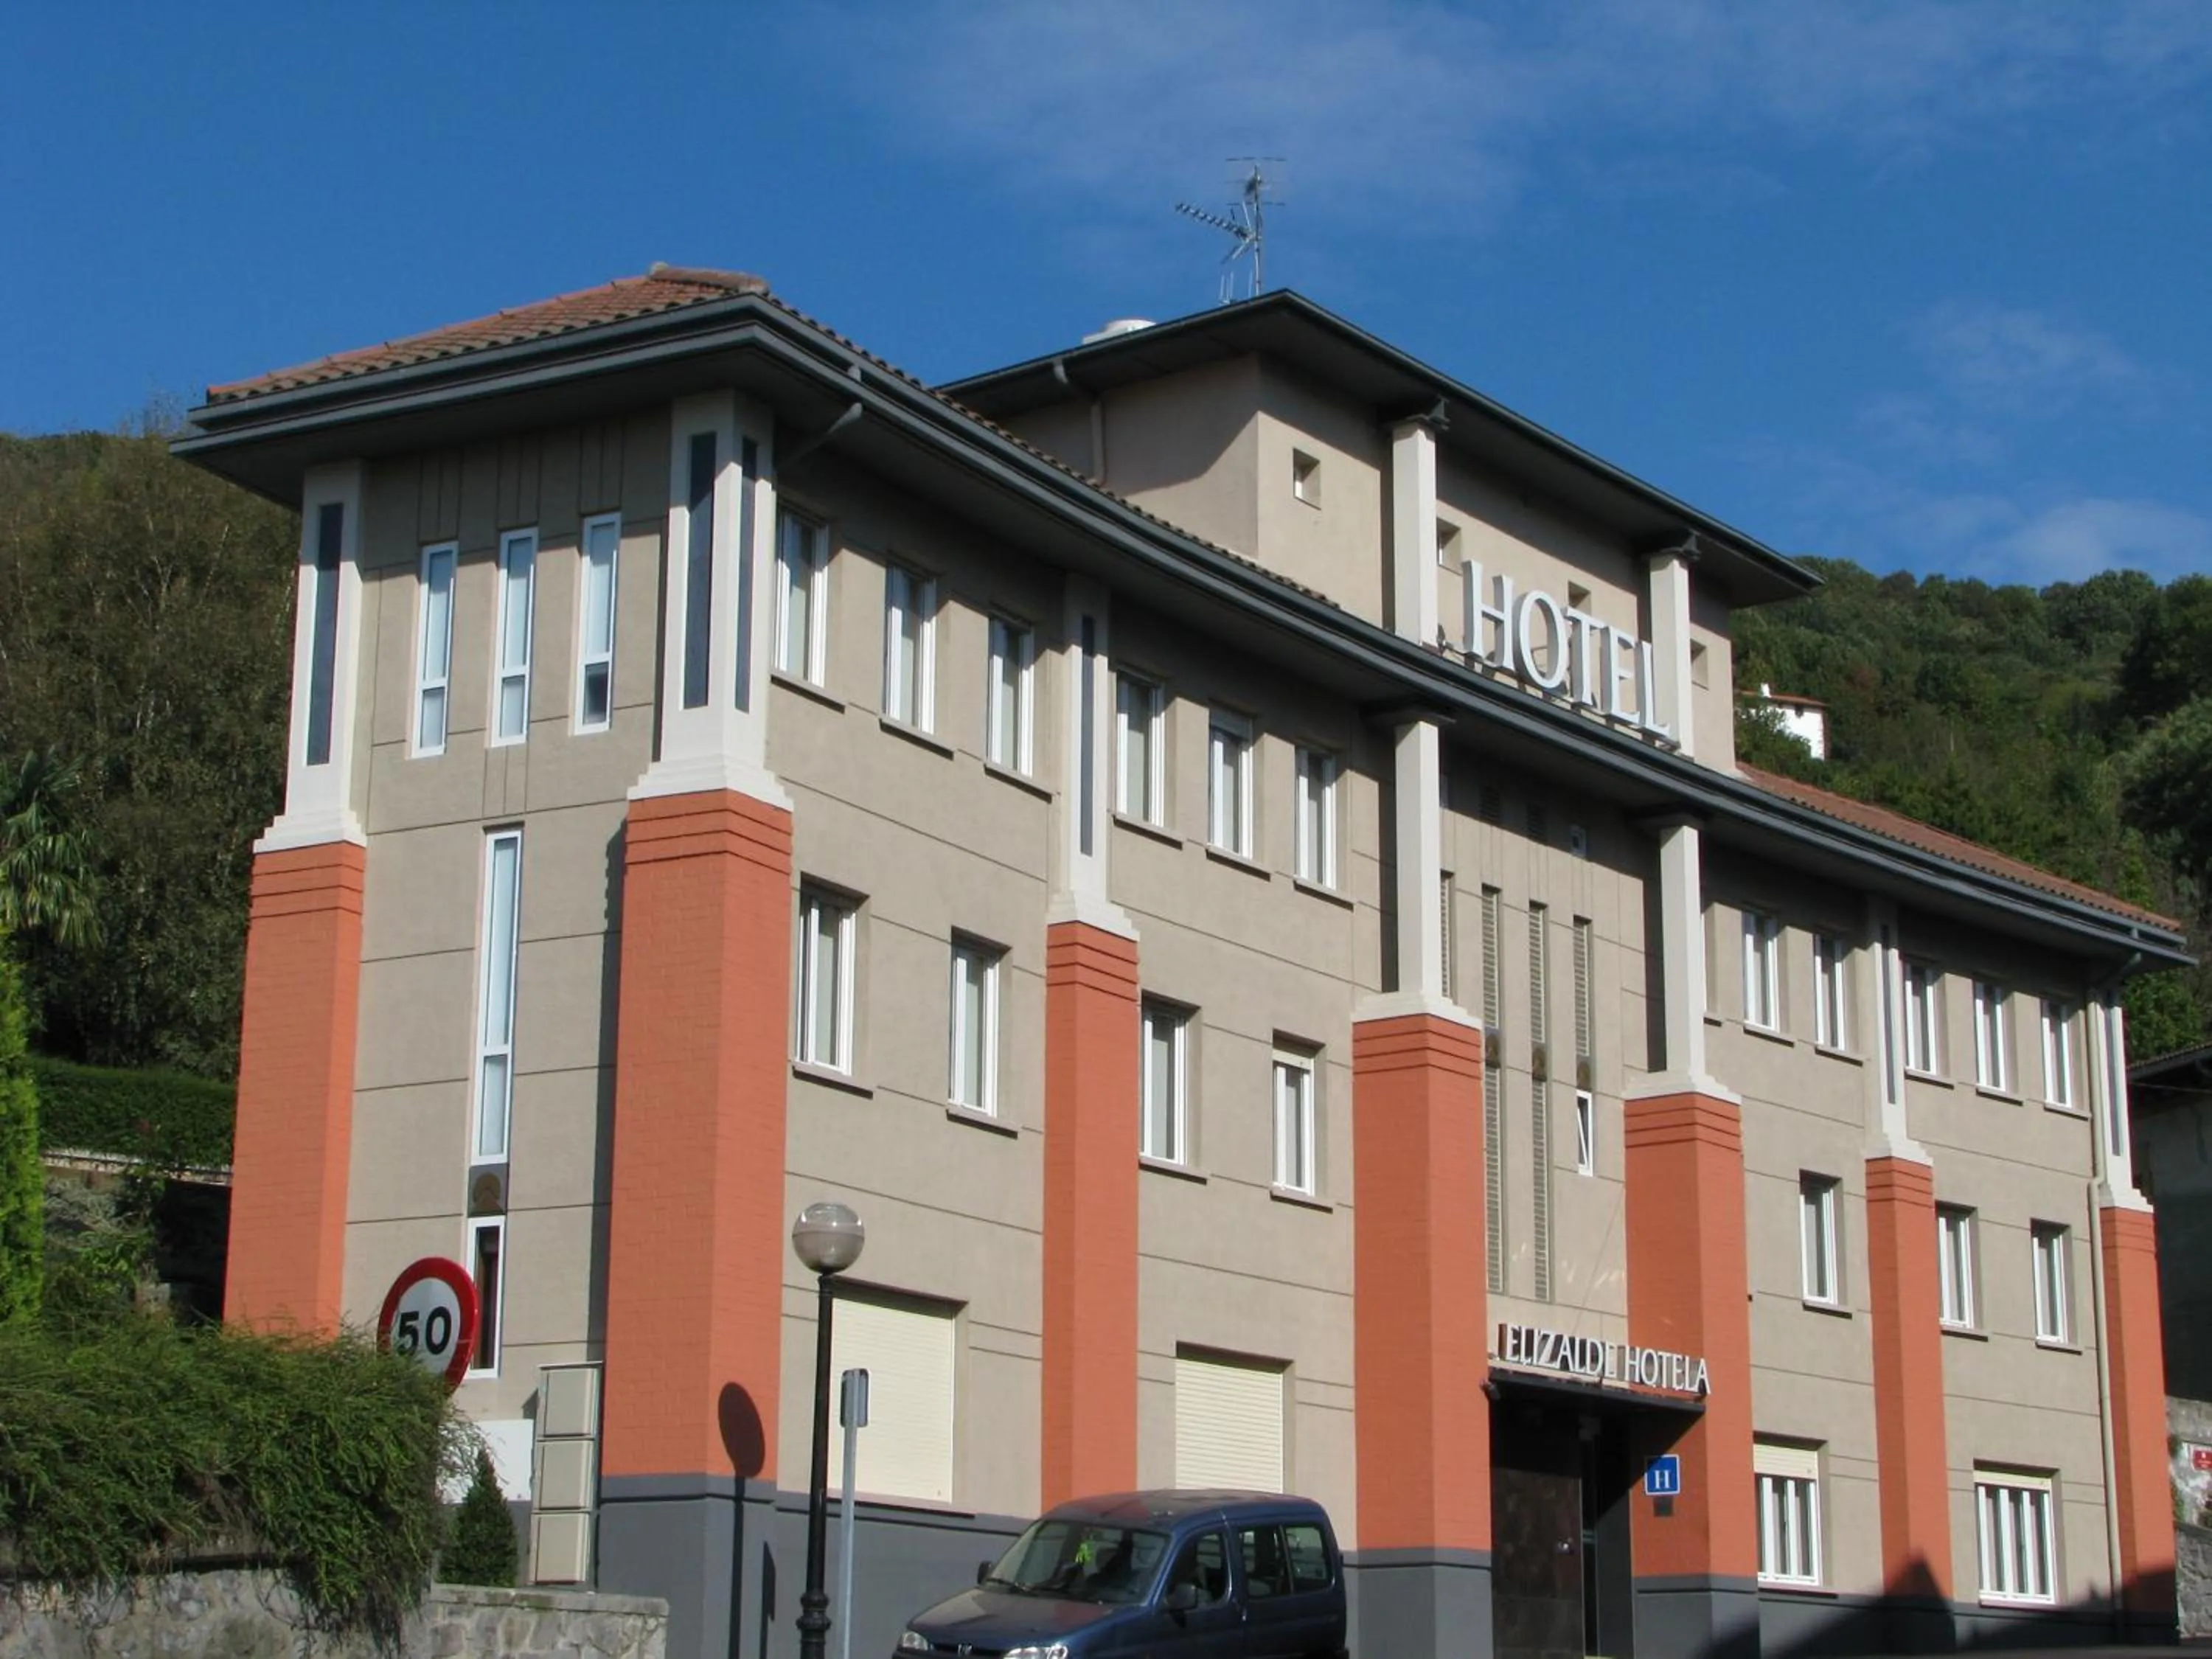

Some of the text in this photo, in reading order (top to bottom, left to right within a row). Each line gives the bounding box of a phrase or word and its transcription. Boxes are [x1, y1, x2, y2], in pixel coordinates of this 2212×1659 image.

[1463, 560, 1670, 737] HOTEL
[397, 1306, 452, 1355] 50
[1506, 1323, 1711, 1394] ELIZALDE HOTELA
